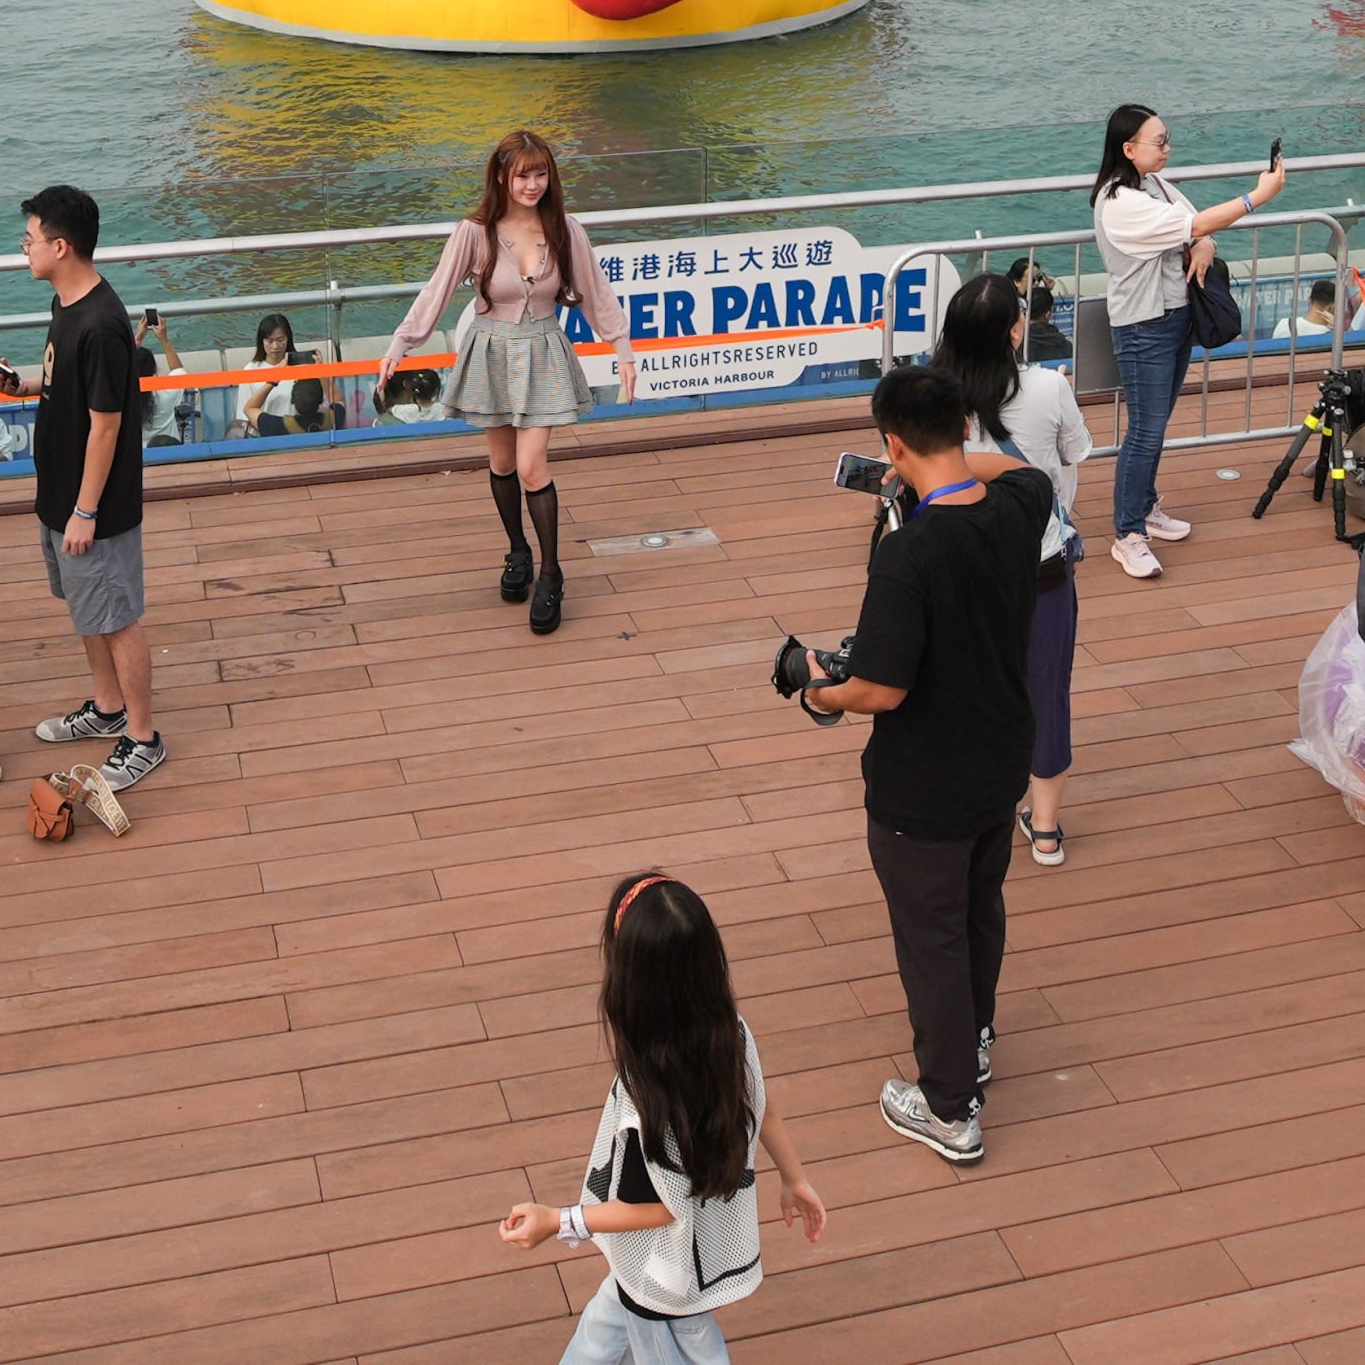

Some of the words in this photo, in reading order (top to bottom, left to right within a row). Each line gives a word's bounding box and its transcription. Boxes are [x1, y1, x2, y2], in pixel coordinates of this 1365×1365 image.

[599, 239, 833, 283] 維港海上大巡遊
[712, 268, 927, 335] PARADE
[641, 342, 818, 372] ALLRIGHTSRESERVED
[650, 377, 709, 391] VICTORIA
[714, 370, 775, 384] HARBOUR
